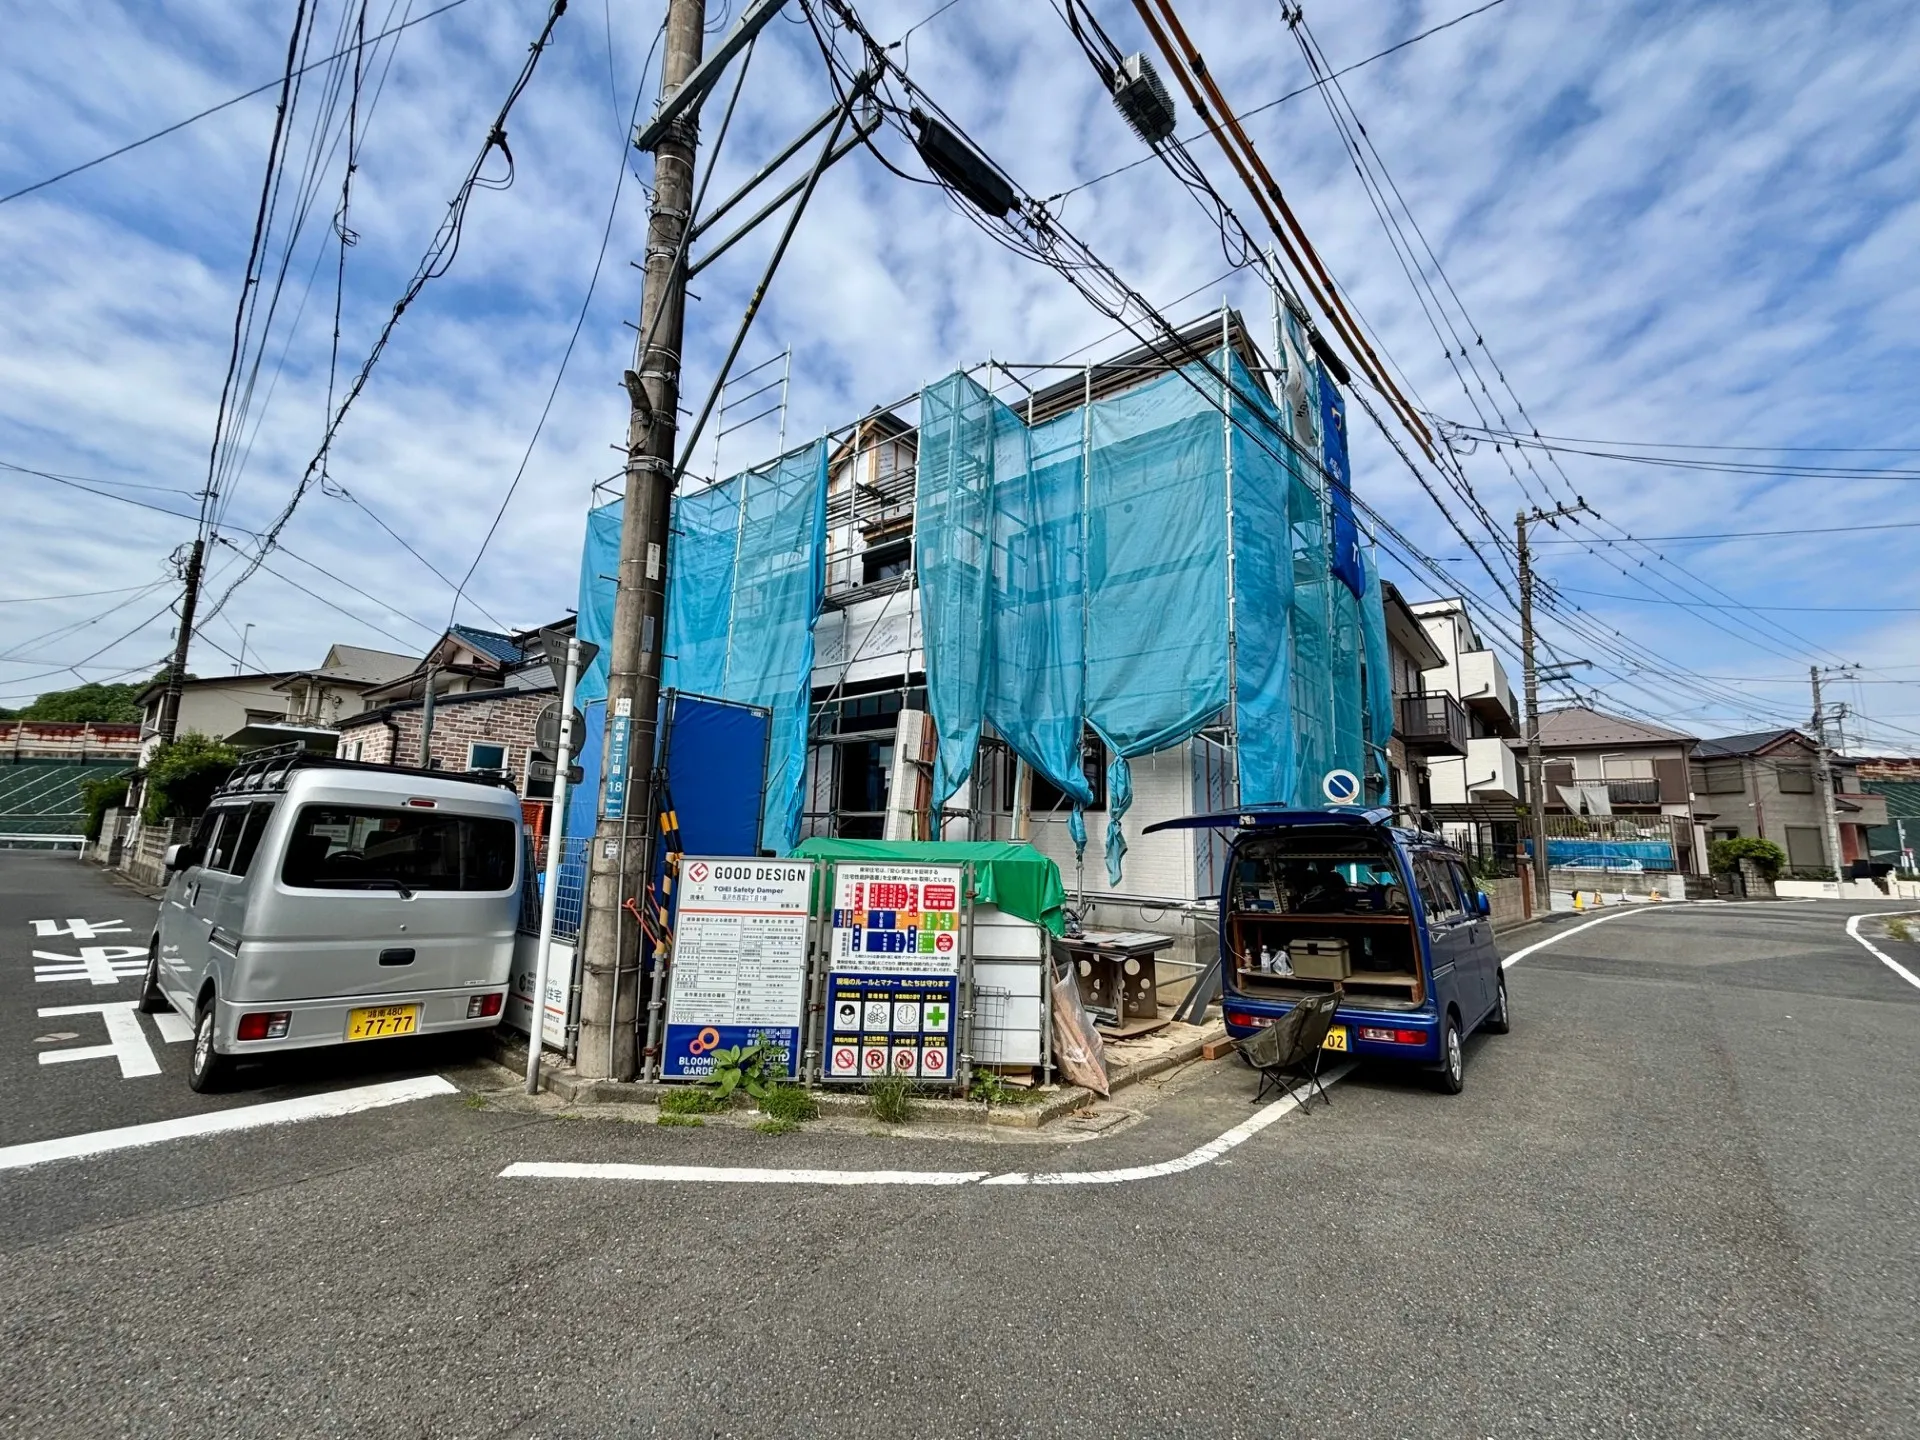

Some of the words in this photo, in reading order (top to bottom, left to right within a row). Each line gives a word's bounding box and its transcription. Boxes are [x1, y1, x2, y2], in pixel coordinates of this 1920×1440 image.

[612, 721, 625, 774] 西富二丁目
[610, 781, 622, 792] 18
[715, 867, 751, 880] GOOD
[756, 868, 806, 881] DESIGN
[733, 886, 755, 894] Safety
[757, 886, 784, 895] Damper
[836, 977, 900, 986] 現場のルールとマナー
[901, 979, 950, 987] 私たちは守ります
[368, 1008, 386, 1018] 湘南
[387, 1007, 403, 1016] 480
[354, 1025, 361, 1033] よ
[366, 1016, 412, 1036] 77-77
[678, 1056, 720, 1065] BLOOMIN
[683, 1066, 715, 1075] GARDE
